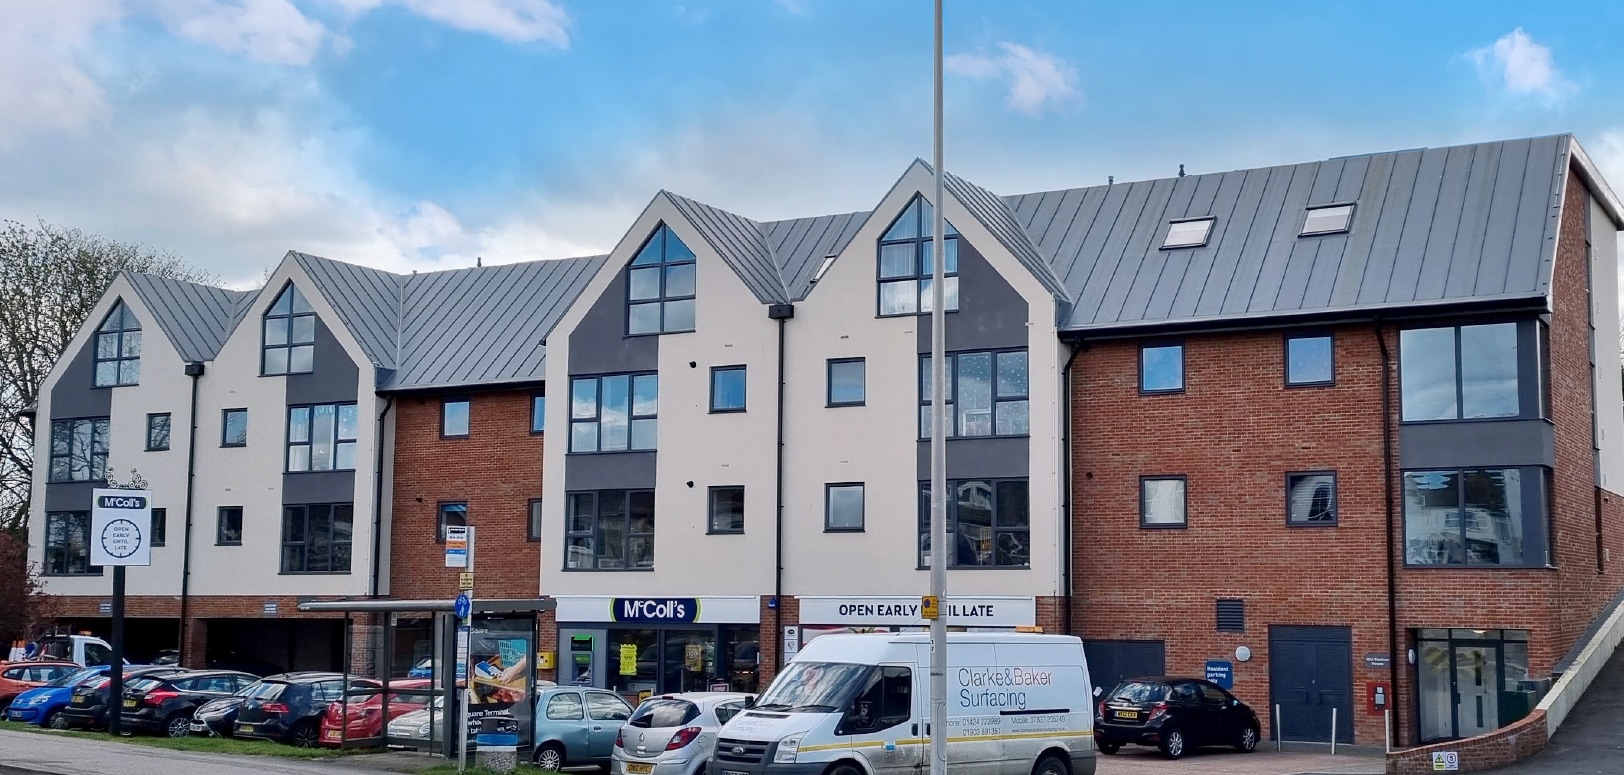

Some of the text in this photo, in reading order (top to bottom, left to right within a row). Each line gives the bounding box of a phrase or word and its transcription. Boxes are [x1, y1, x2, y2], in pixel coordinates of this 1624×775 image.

[104, 497, 140, 507] McColl's
[624, 600, 686, 618] McColl's
[838, 604, 874, 616] OPEN
[877, 604, 918, 617] EARLY
[962, 604, 994, 617] LATE
[958, 668, 1053, 687] Clarke&Baker
[960, 688, 1026, 710] Surfacing
